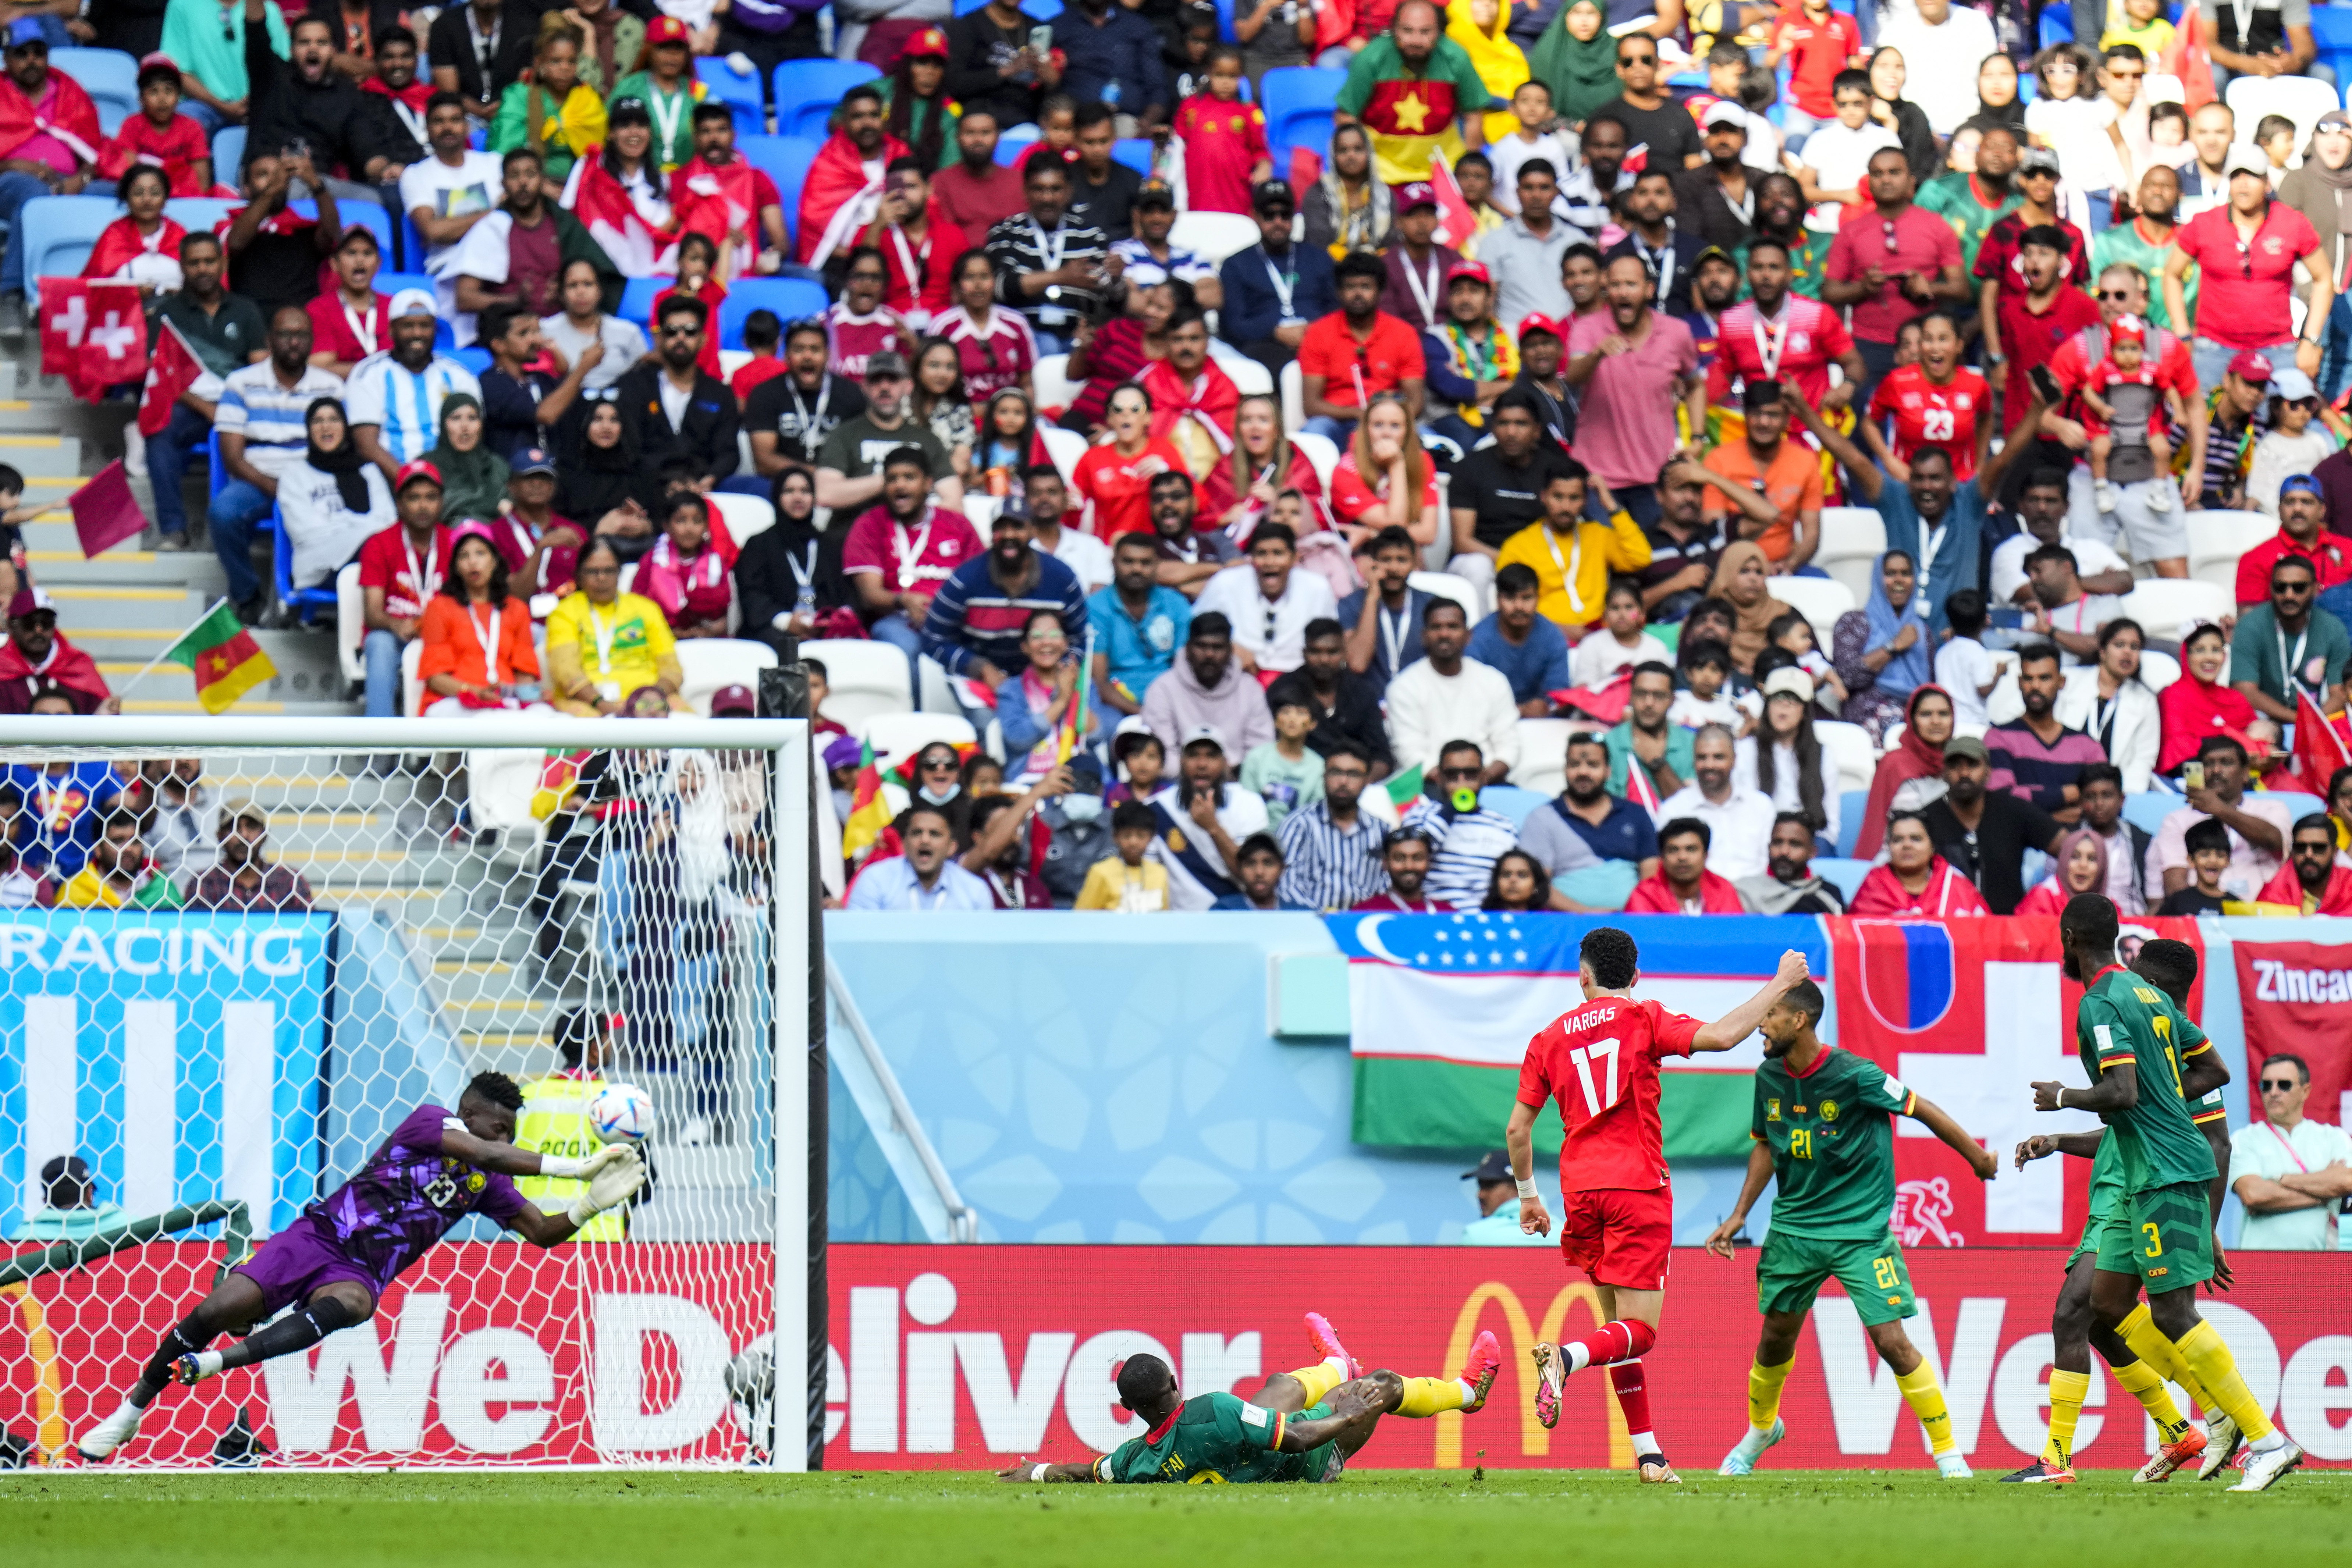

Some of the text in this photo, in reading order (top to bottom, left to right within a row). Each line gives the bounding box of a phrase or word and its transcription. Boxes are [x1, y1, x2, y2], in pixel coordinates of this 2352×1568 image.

[1923, 408, 1954, 441] 23
[0, 924, 302, 977] RACING
[1563, 1007, 1616, 1034] VARGAS
[1570, 1037, 1620, 1118] 17
[1791, 1129, 1812, 1159] 21
[2142, 1223, 2162, 1257] 3
[1873, 1256, 1900, 1289] 21
[2148, 1267, 2167, 1277] one
[1887, 1296, 1901, 1305] one
[257, 1293, 555, 1454] We
[1812, 1297, 2107, 1457] We
[1617, 1386, 1642, 1395] suisse
[1923, 1412, 1947, 1423] one
[1161, 1451, 1186, 1477] FAÏ
